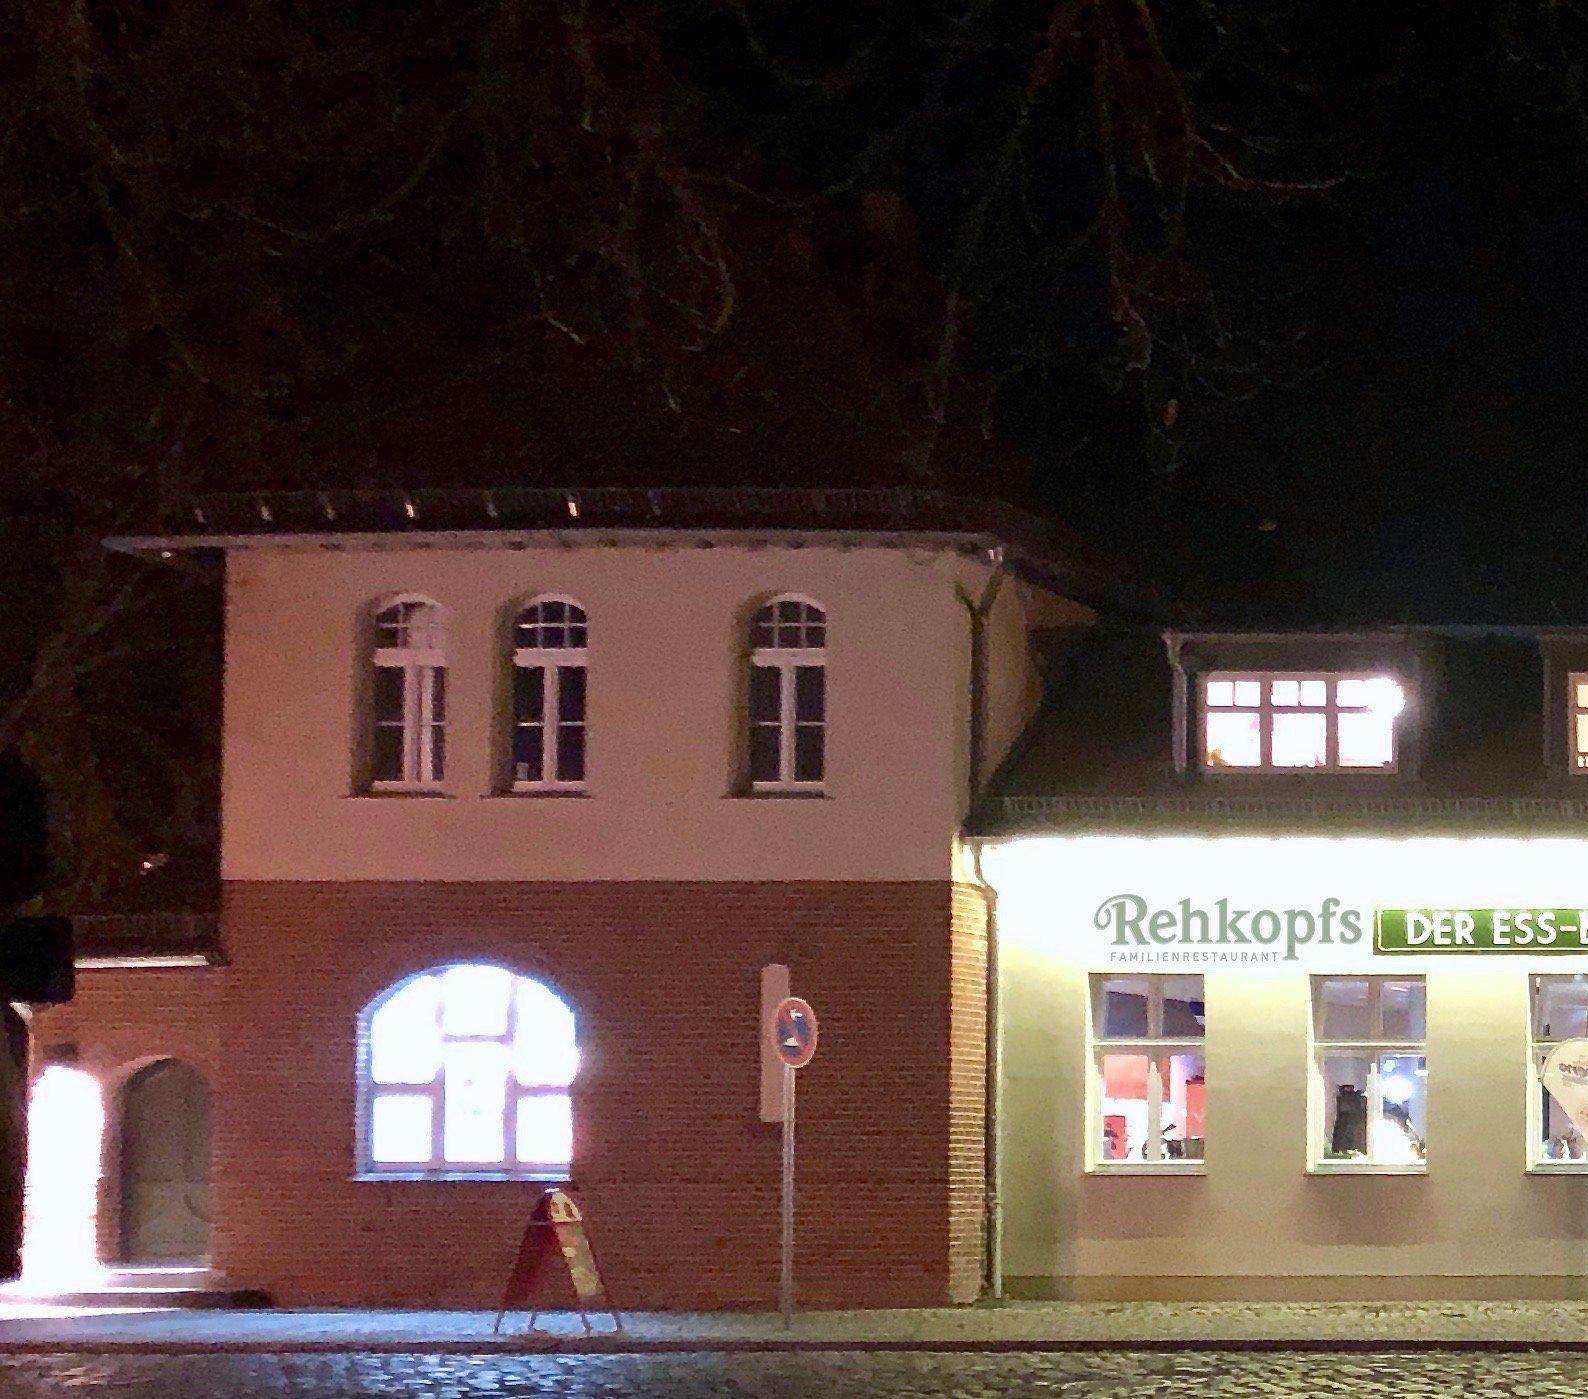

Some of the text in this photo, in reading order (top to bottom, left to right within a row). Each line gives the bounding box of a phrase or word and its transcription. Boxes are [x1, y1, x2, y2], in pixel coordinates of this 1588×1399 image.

[1094, 894, 1362, 961] Rehkopfs
[1405, 911, 1476, 945] DER
[1110, 951, 1279, 962] FAMILIENRESTAURANT
